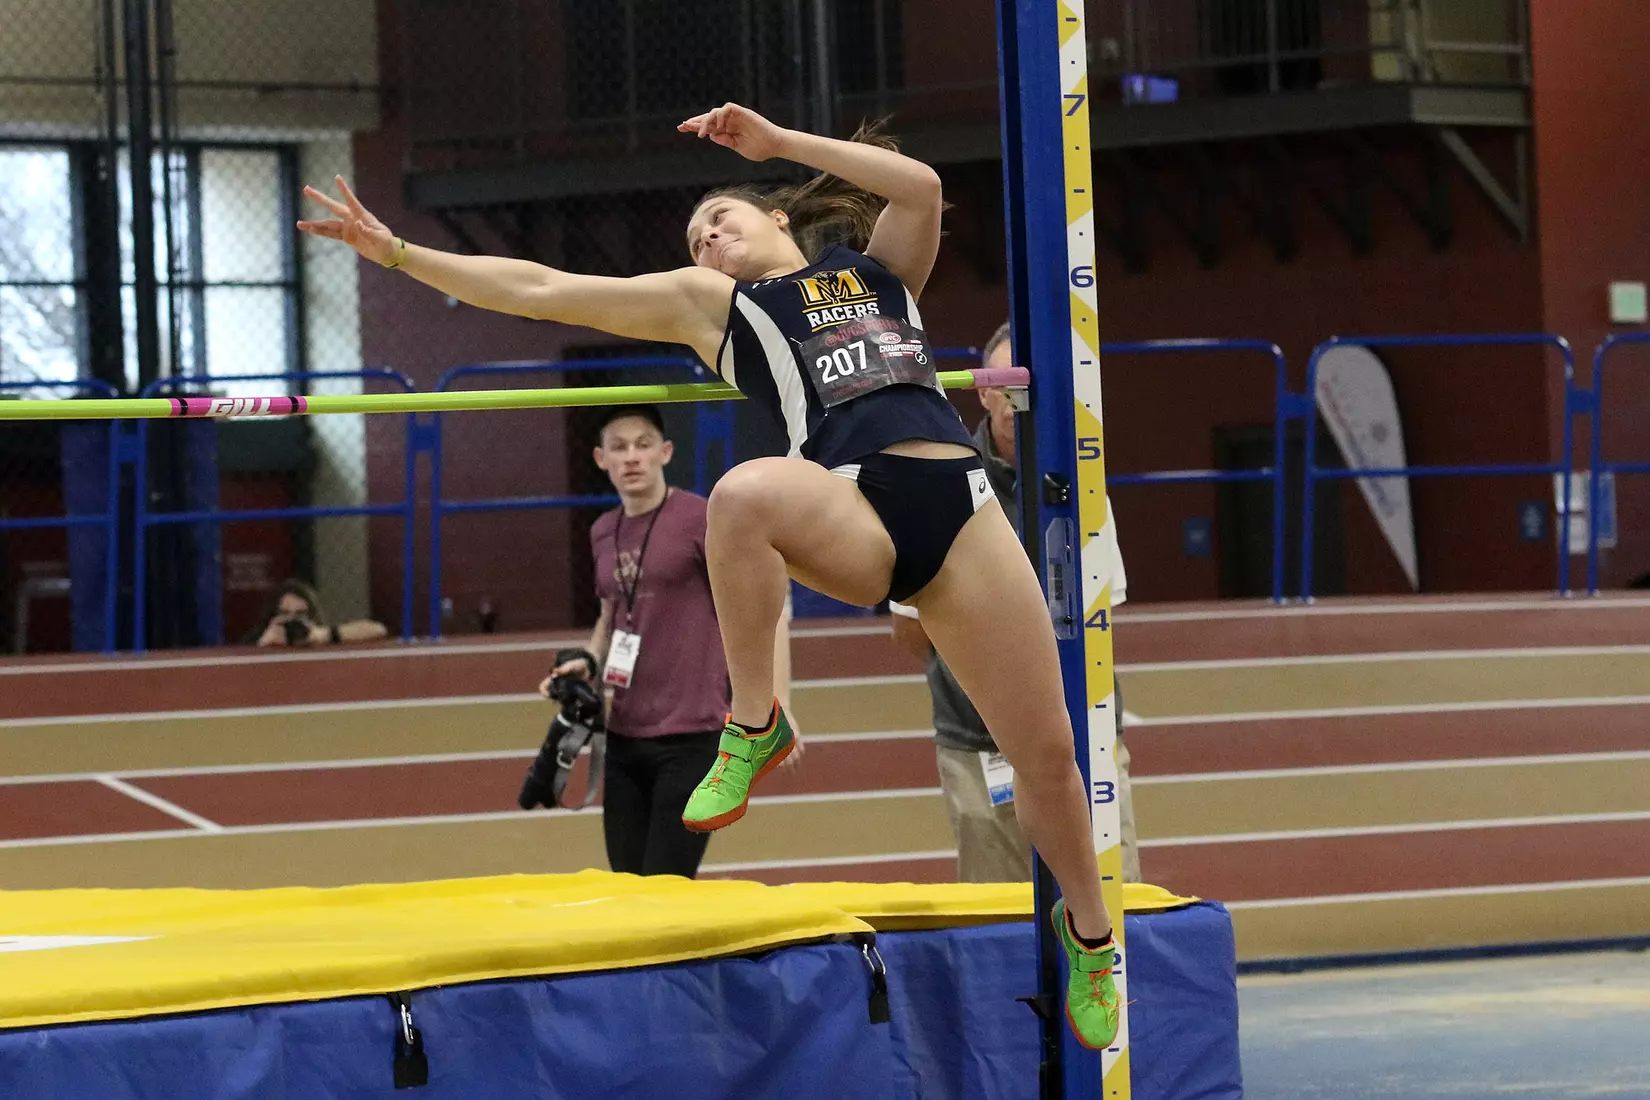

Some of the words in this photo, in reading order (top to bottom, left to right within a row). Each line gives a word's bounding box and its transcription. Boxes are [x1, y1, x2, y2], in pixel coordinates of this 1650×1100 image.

[1063, 94, 1085, 117] 7
[1071, 265, 1094, 287] 6
[806, 302, 880, 328] RACERS
[816, 339, 867, 384] 207
[205, 398, 272, 416] GILL
[1078, 437, 1101, 460] 5
[1085, 608, 1110, 631] 4
[1093, 781, 1115, 804] 3
